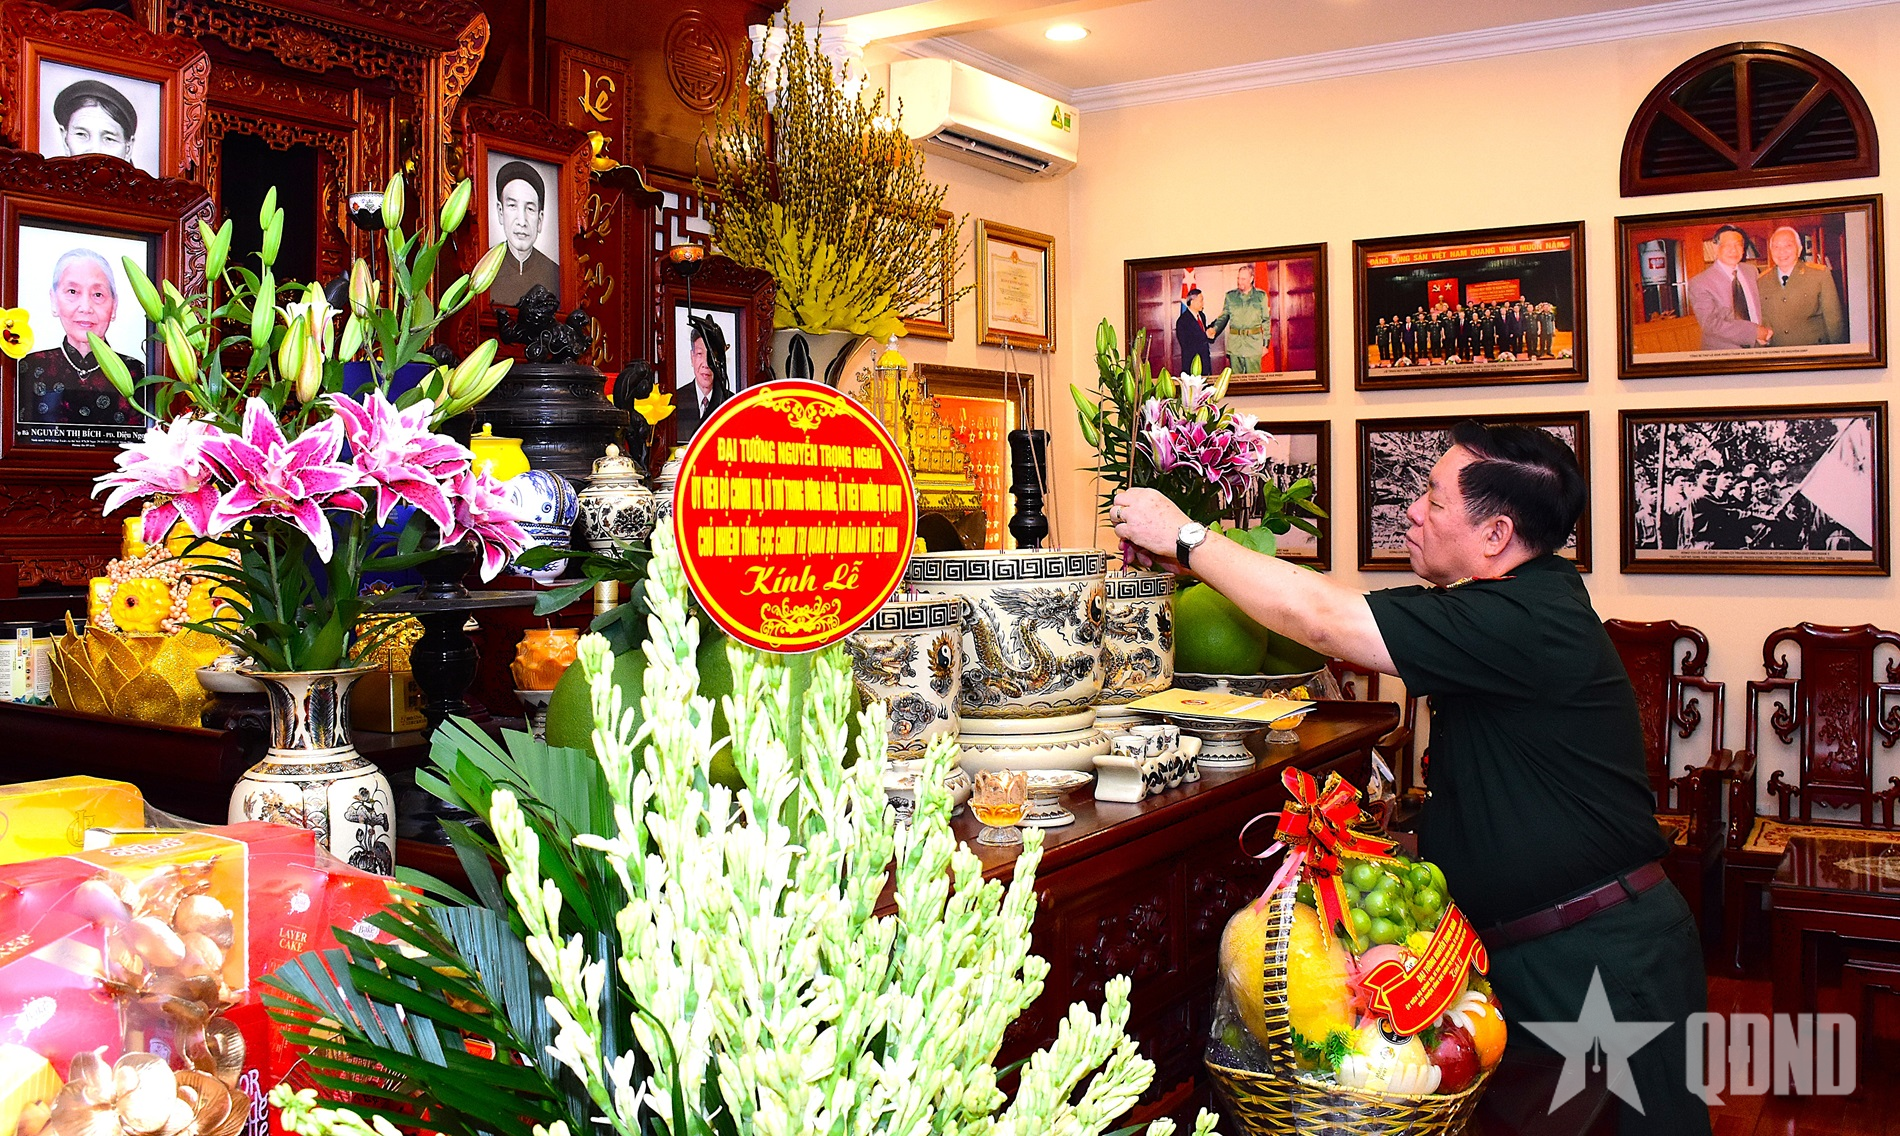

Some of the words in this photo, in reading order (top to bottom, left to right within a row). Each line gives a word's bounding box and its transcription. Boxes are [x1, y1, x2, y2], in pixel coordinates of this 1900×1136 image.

[1369, 255, 1388, 265] ĐẢNG
[1391, 253, 1410, 265] CỘNG
[1413, 251, 1428, 262] SẢN
[1431, 250, 1446, 261] VIỆT
[1450, 249, 1467, 258] NAM
[1470, 247, 1495, 257] QUANG
[1498, 244, 1516, 253] VINH
[1519, 241, 1542, 252] MUÔN
[1545, 240, 1565, 249] NĂM
[31, 426, 65, 437] NGUYỄN
[66, 429, 81, 439] THỊ
[82, 427, 101, 438] BÍCH
[717, 437, 737, 467] ĐẠI
[739, 434, 776, 464] TƯỚNG
[777, 435, 818, 467] NGUYỄN
[819, 444, 852, 472] TRỌNG
[853, 444, 883, 469] NGHĨA
[740, 565, 817, 596] Kính
[823, 560, 863, 591] Lễ
[279, 928, 308, 943] LAYER
[279, 938, 304, 952] CAKE
